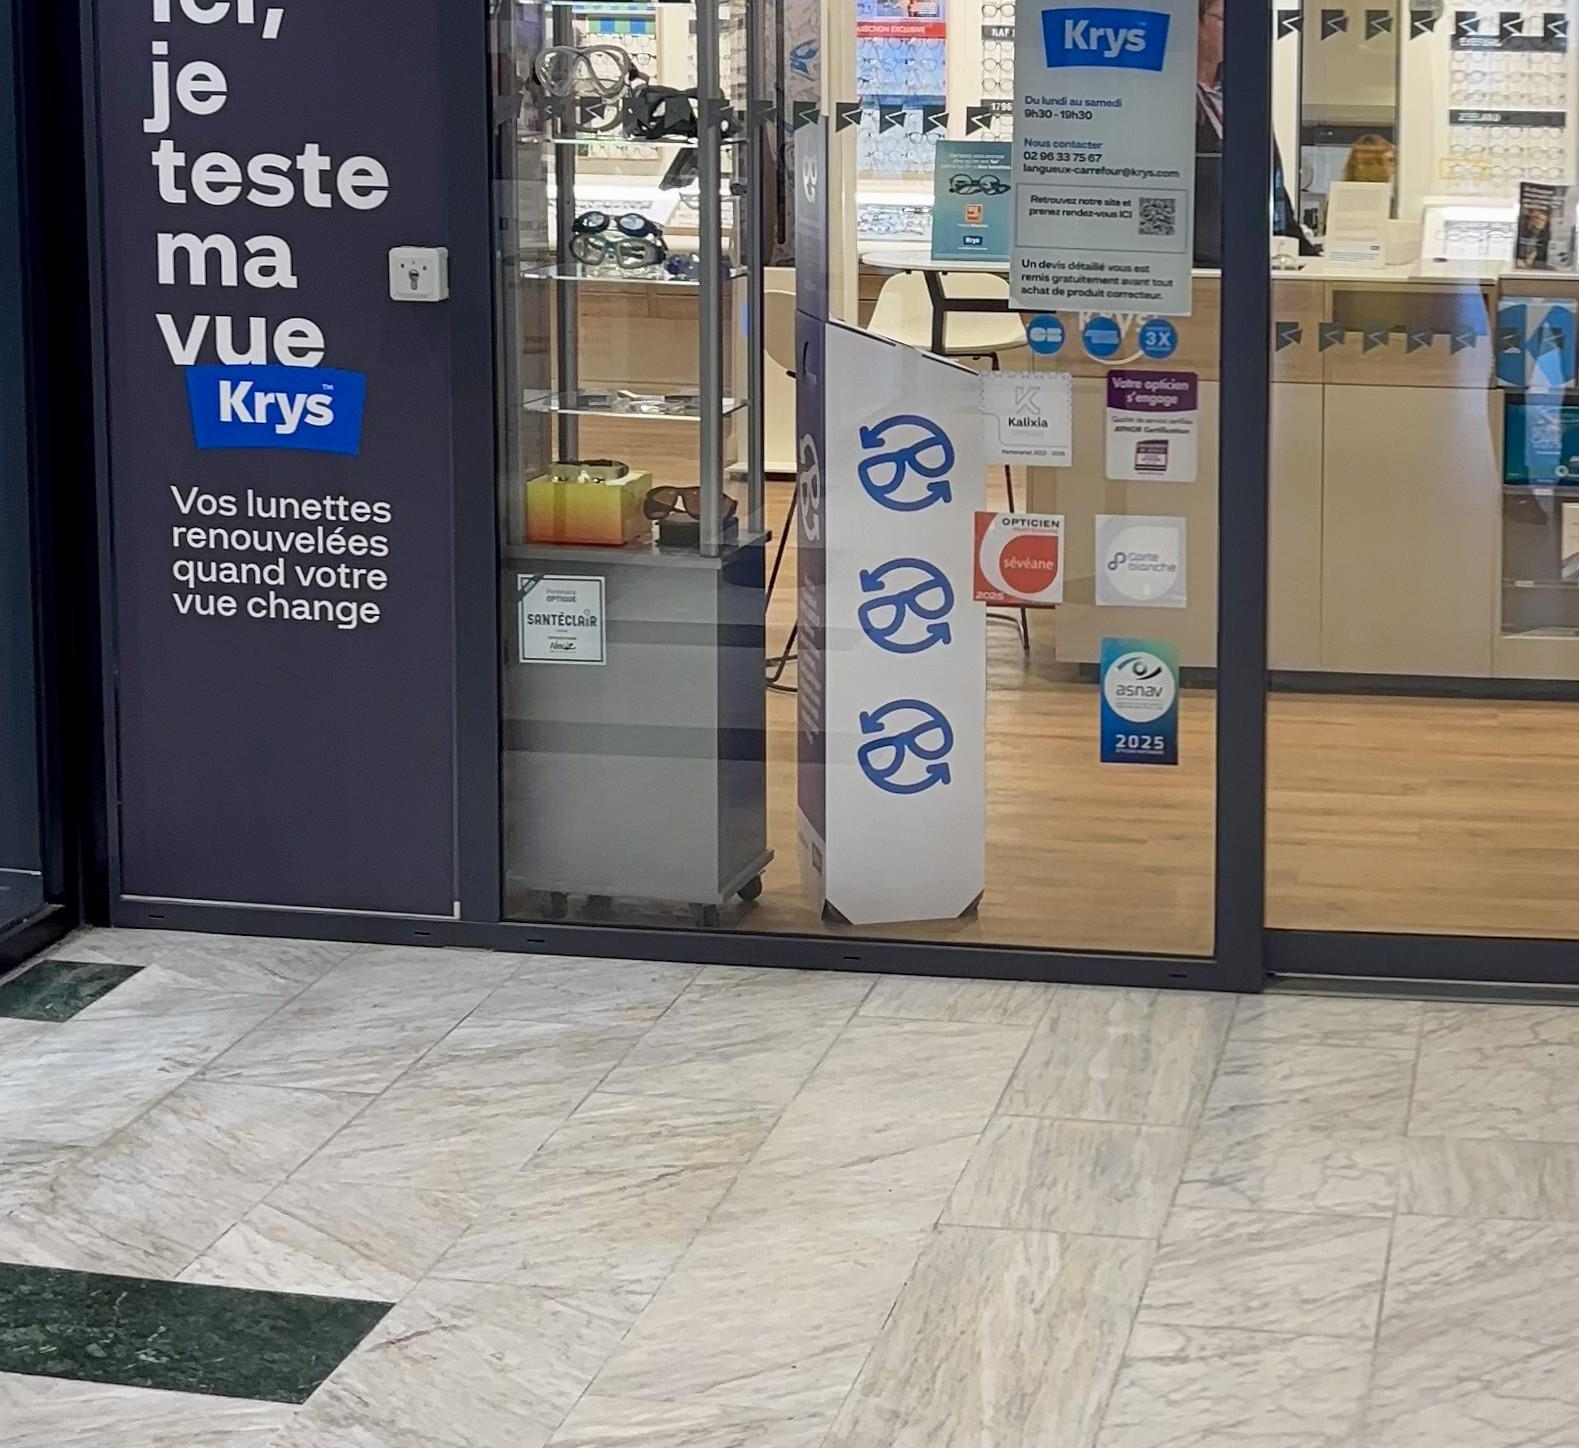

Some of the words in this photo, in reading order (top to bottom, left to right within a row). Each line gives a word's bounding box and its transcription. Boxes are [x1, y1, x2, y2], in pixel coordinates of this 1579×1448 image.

[1063, 18, 1147, 58] Krys
[143, 41, 229, 133] je
[1024, 95, 1039, 106] Du
[1041, 95, 1068, 106] lundi
[1069, 98, 1082, 107] au
[1084, 96, 1122, 108] samedi
[1024, 108, 1053, 120] 9h30
[1060, 110, 1093, 121] 19h30
[1023, 138, 1051, 149] Nous
[1052, 140, 1103, 150] contacter
[1023, 151, 1039, 161] 02
[151, 139, 390, 210] teste
[156, 232, 298, 290] ma
[1021, 259, 1037, 269] Un
[1038, 260, 1066, 270] devis
[1021, 272, 1050, 283] remis
[1051, 274, 1120, 288] gratuitement
[1020, 285, 1050, 296] achat
[1051, 286, 1066, 296] de
[1066, 287, 1105, 299] produit
[156, 313, 325, 368] vue
[1112, 377, 1143, 389] Votre
[1144, 378, 1190, 392] opticien
[1126, 391, 1179, 407] s'engage
[218, 380, 335, 435] Krys
[1008, 417, 1049, 428] Kalixia
[170, 485, 238, 515] Vos
[247, 489, 392, 524] lunettes
[1001, 517, 1060, 528] OPTICIEN
[172, 526, 390, 557] renouvelées
[1003, 555, 1055, 570] sévéane
[172, 559, 286, 595] quand
[294, 569, 389, 591] votre
[172, 593, 238, 617] vue
[246, 593, 381, 630] change
[1115, 684, 1164, 698] asnav
[1115, 734, 1165, 750] 2025
